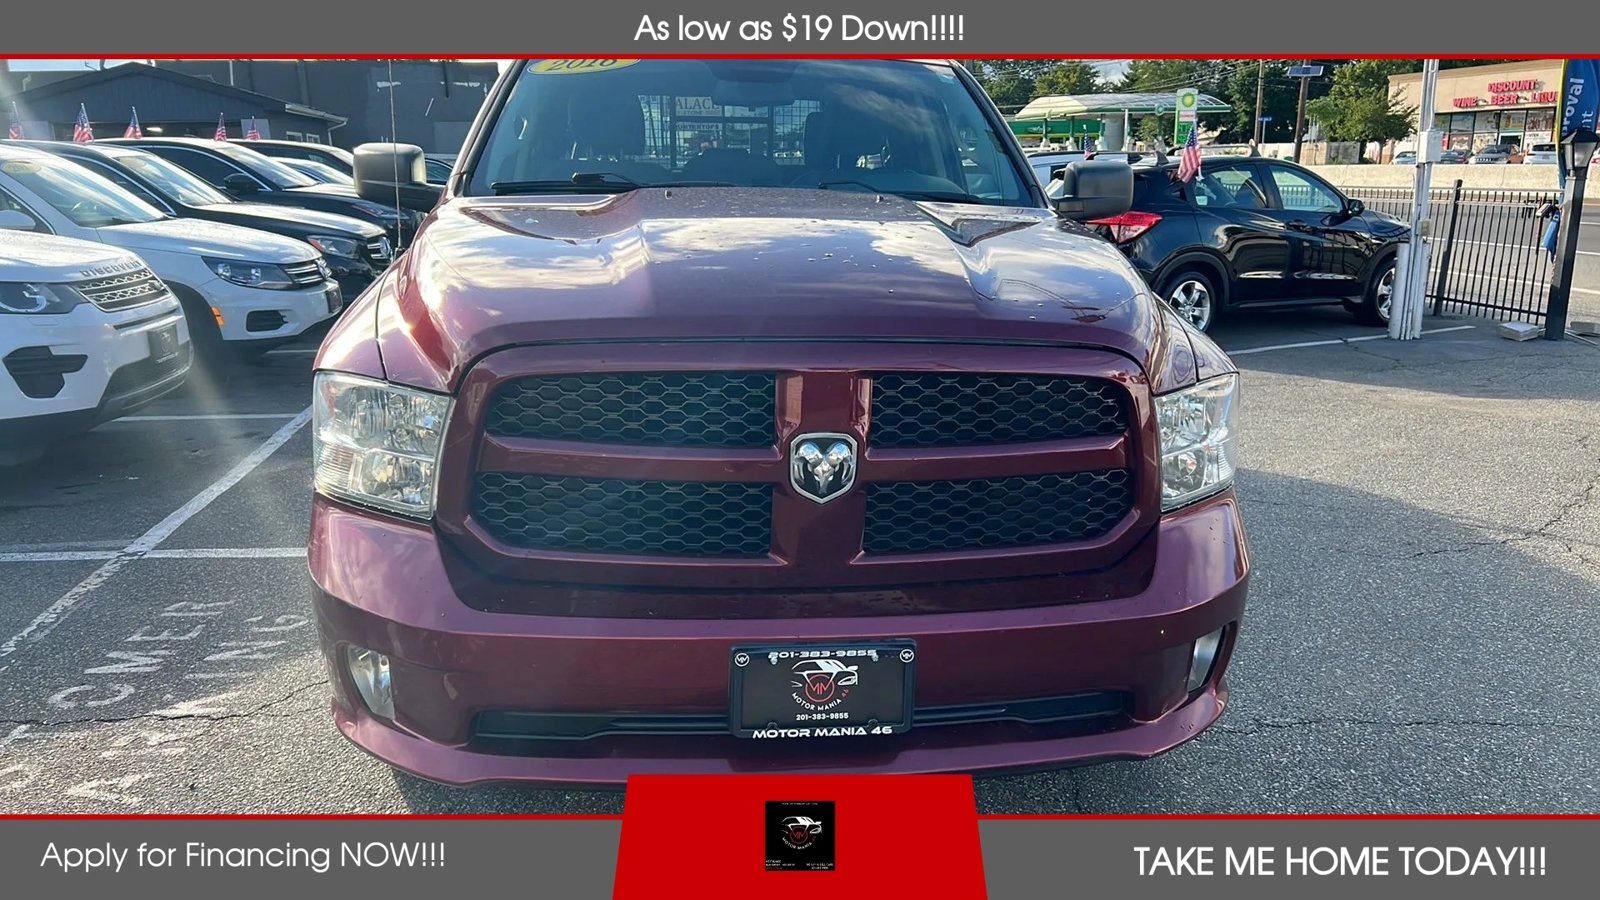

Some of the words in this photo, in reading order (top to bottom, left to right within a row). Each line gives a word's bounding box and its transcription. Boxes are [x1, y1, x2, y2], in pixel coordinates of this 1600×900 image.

[1487, 79, 1537, 92] DISCOUNT
[1453, 96, 1477, 108] WINE
[1491, 93, 1518, 105] BEER
[1531, 91, 1559, 103] LIQU
[792, 692, 816, 711] MOTOR
[817, 698, 842, 711] MANIA
[795, 712, 849, 721] 201-383-9855
[752, 728, 811, 738] MOTOR
[814, 726, 867, 737] MANIA
[871, 726, 893, 735] 46
